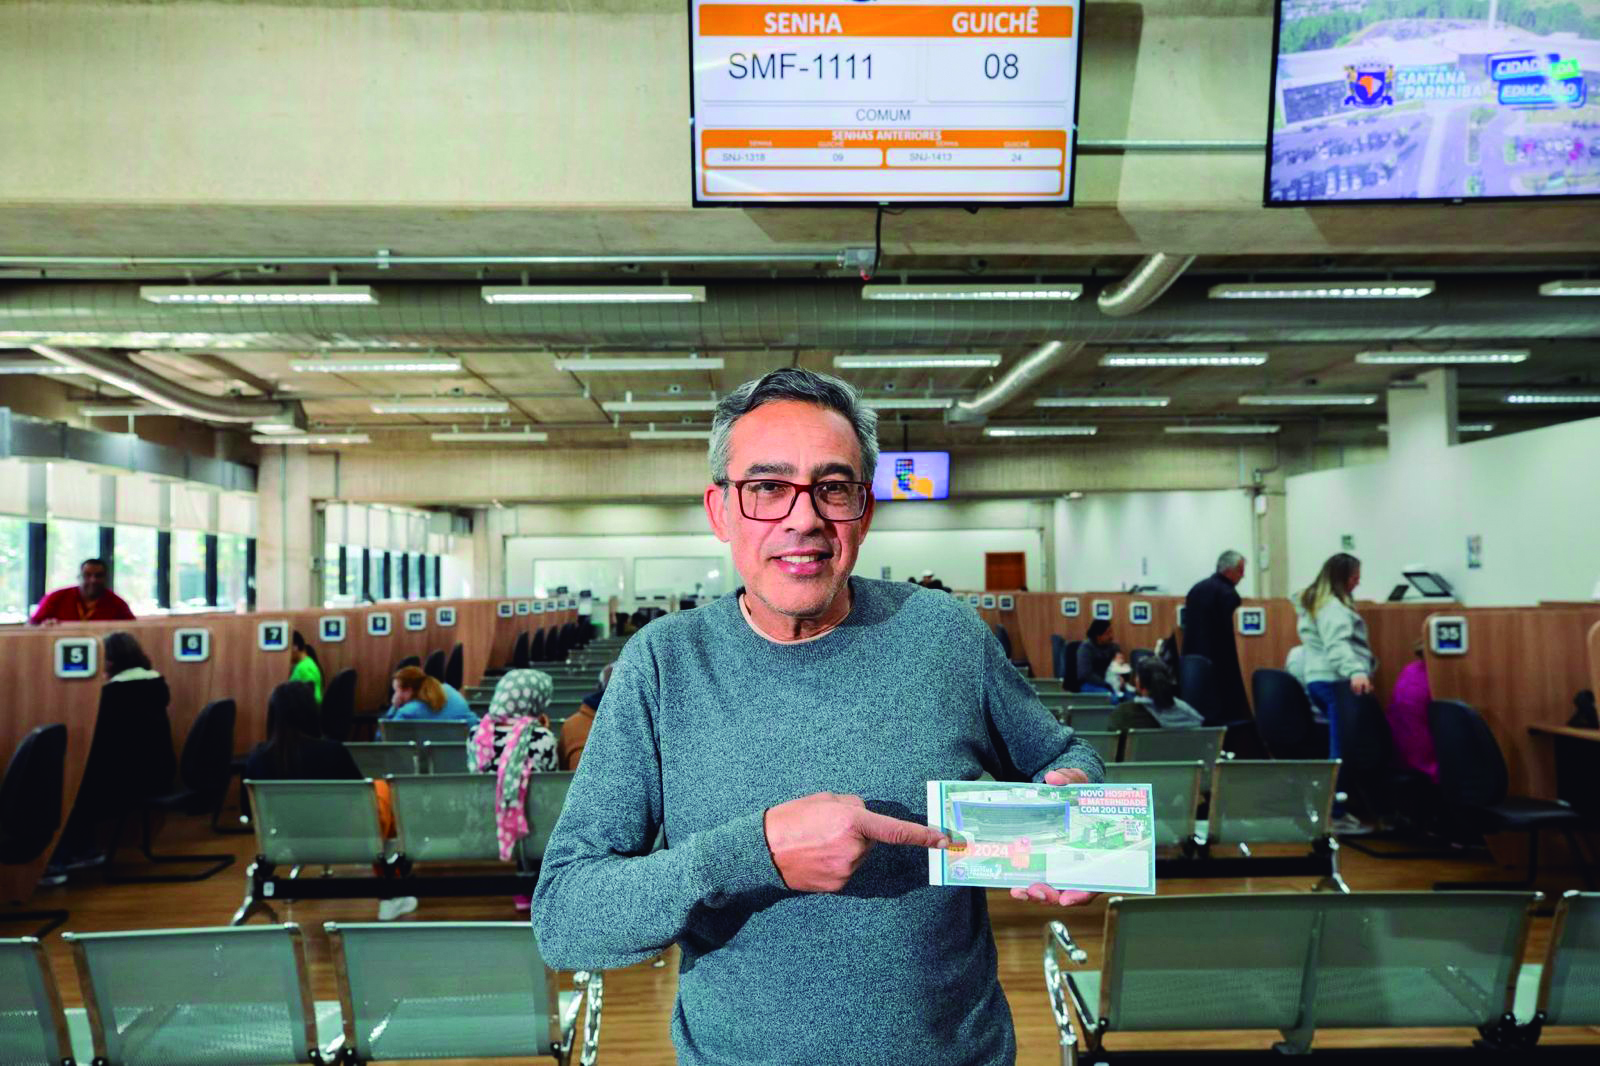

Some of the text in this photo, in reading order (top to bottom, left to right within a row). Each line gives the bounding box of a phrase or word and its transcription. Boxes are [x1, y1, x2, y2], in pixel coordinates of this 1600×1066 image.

[764, 12, 843, 34] SENHA
[952, 8, 1039, 34] GUICHÊ
[728, 53, 873, 80] SMF-1111
[983, 53, 1019, 80] 08
[1397, 70, 1467, 86] SANTANA
[856, 108, 912, 122] COMUM
[832, 130, 942, 141] SENHAS ANTERIORES
[270, 628, 280, 639] 7
[1438, 627, 1460, 640] 35
[187, 636, 199, 650] 6
[70, 647, 83, 663] 5
[1104, 790, 1147, 798] HOSPITAL
[1087, 798, 1147, 806] MATERNIDADE
[1118, 806, 1147, 814] LEITOS
[974, 843, 1008, 857] 2024
